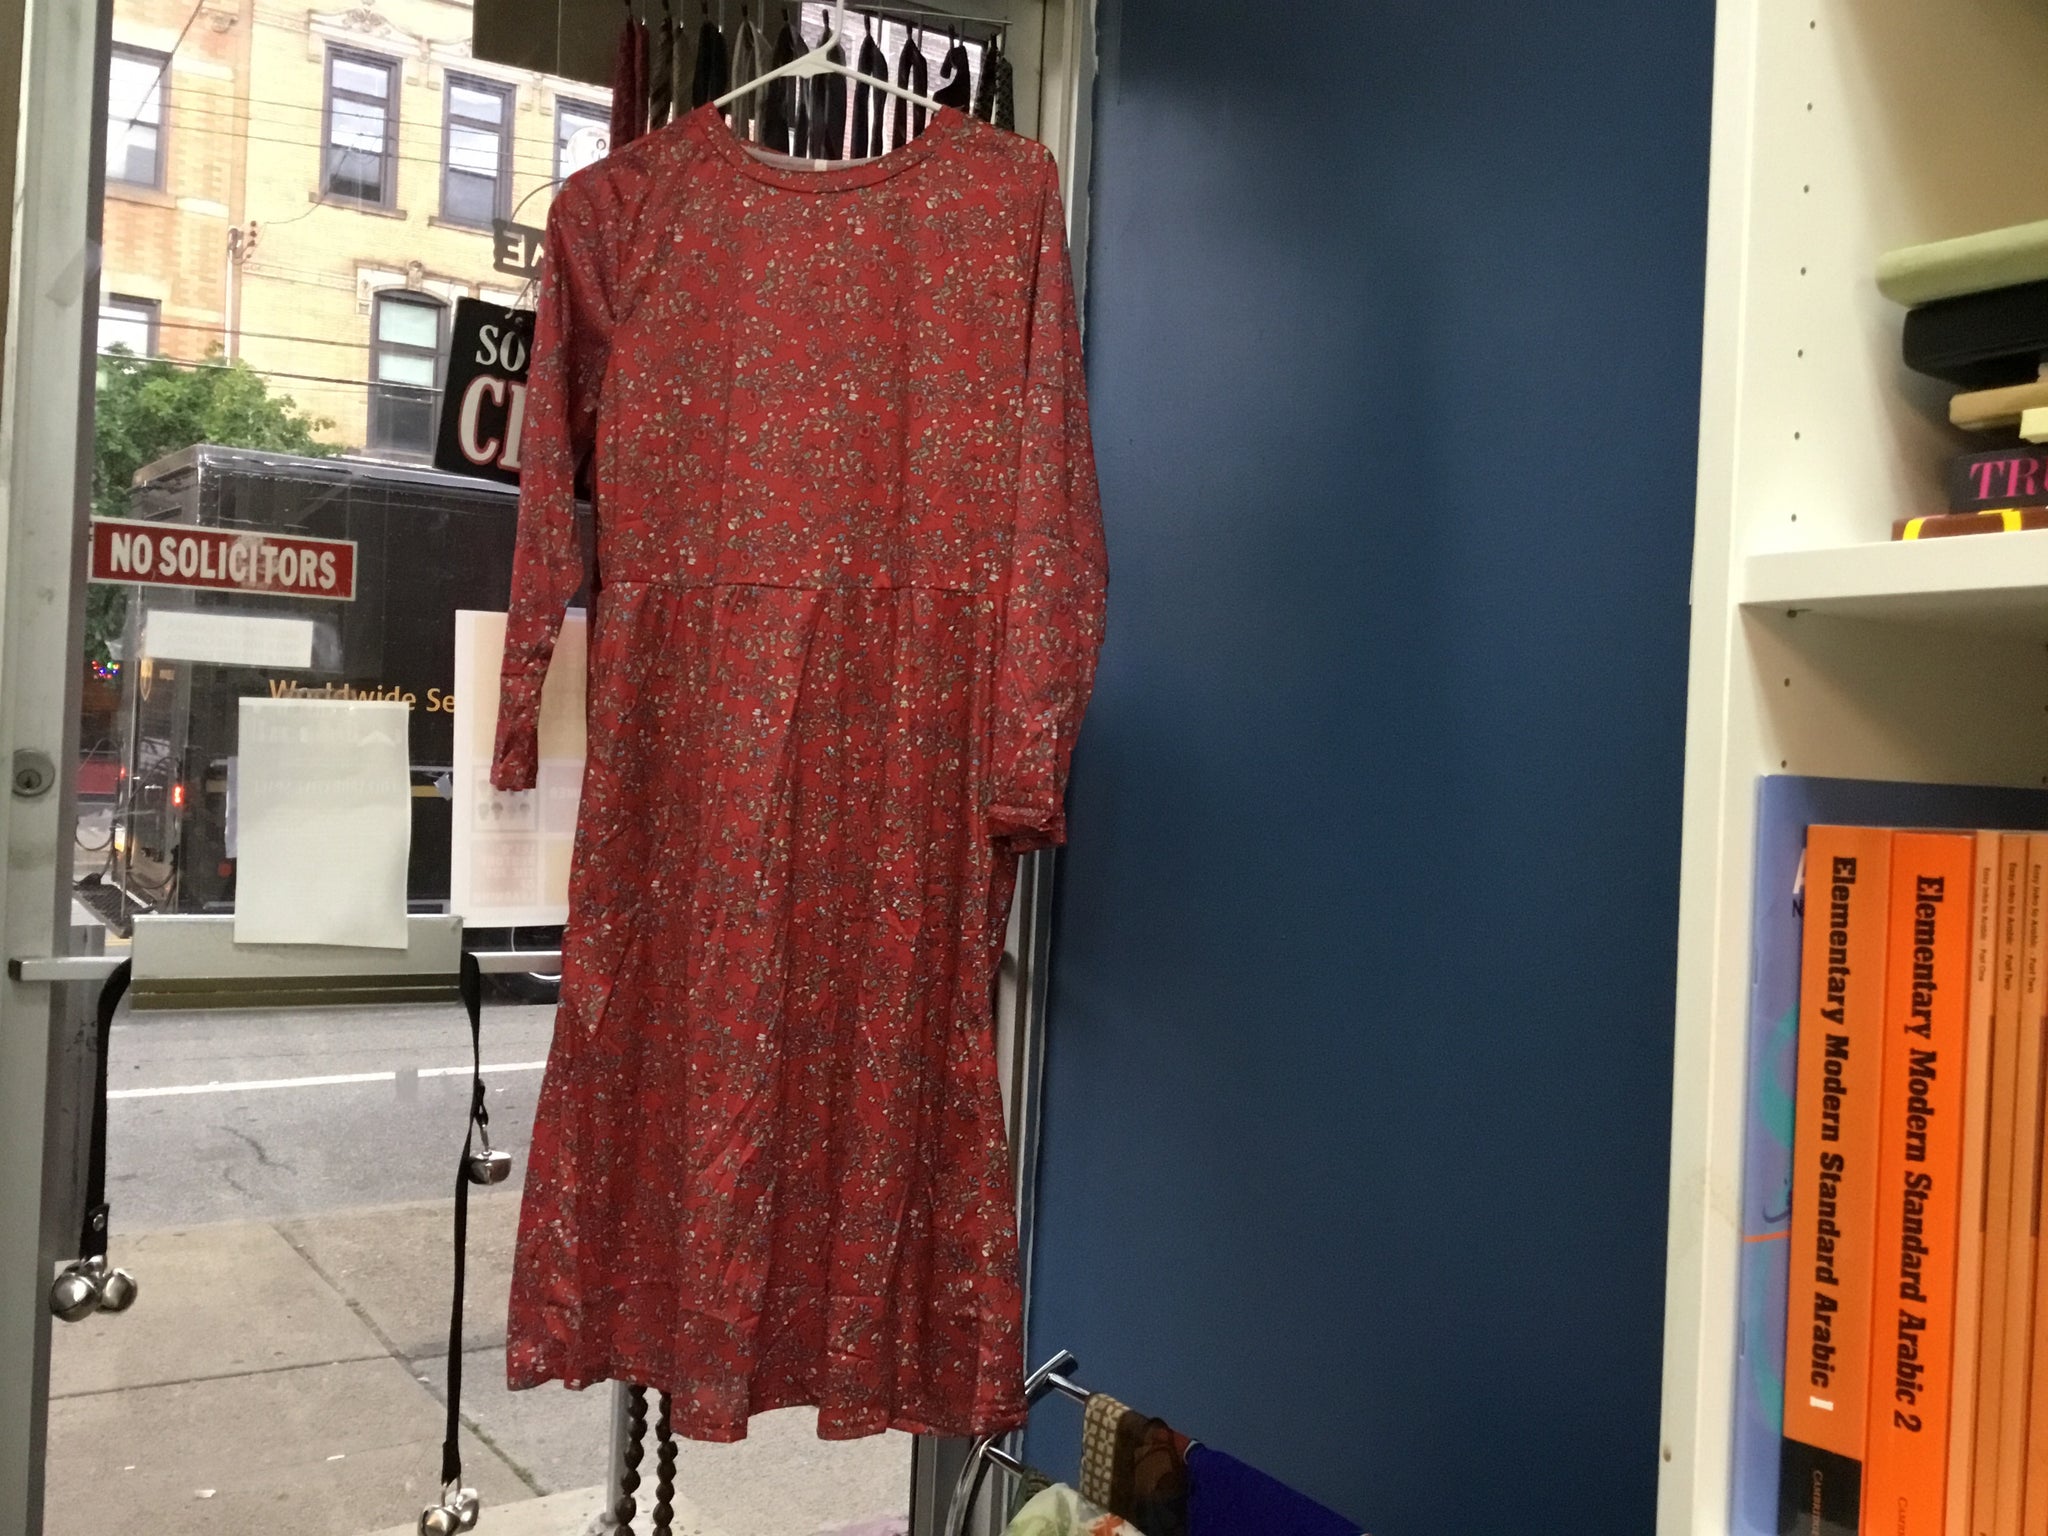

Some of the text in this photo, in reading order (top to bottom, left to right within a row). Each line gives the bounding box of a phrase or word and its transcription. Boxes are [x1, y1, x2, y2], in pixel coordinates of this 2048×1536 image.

[475, 324, 529, 374] SO
[110, 532, 337, 590] NO SOLICITORS
[1820, 856, 1857, 1025] Elementary
[1821, 1034, 1849, 1142] Modern
[1894, 875, 1945, 1433] Elementary Modern Standard Arabic 2
[1817, 1152, 1845, 1286] Standard
[1811, 1292, 1838, 1389] Arabic
